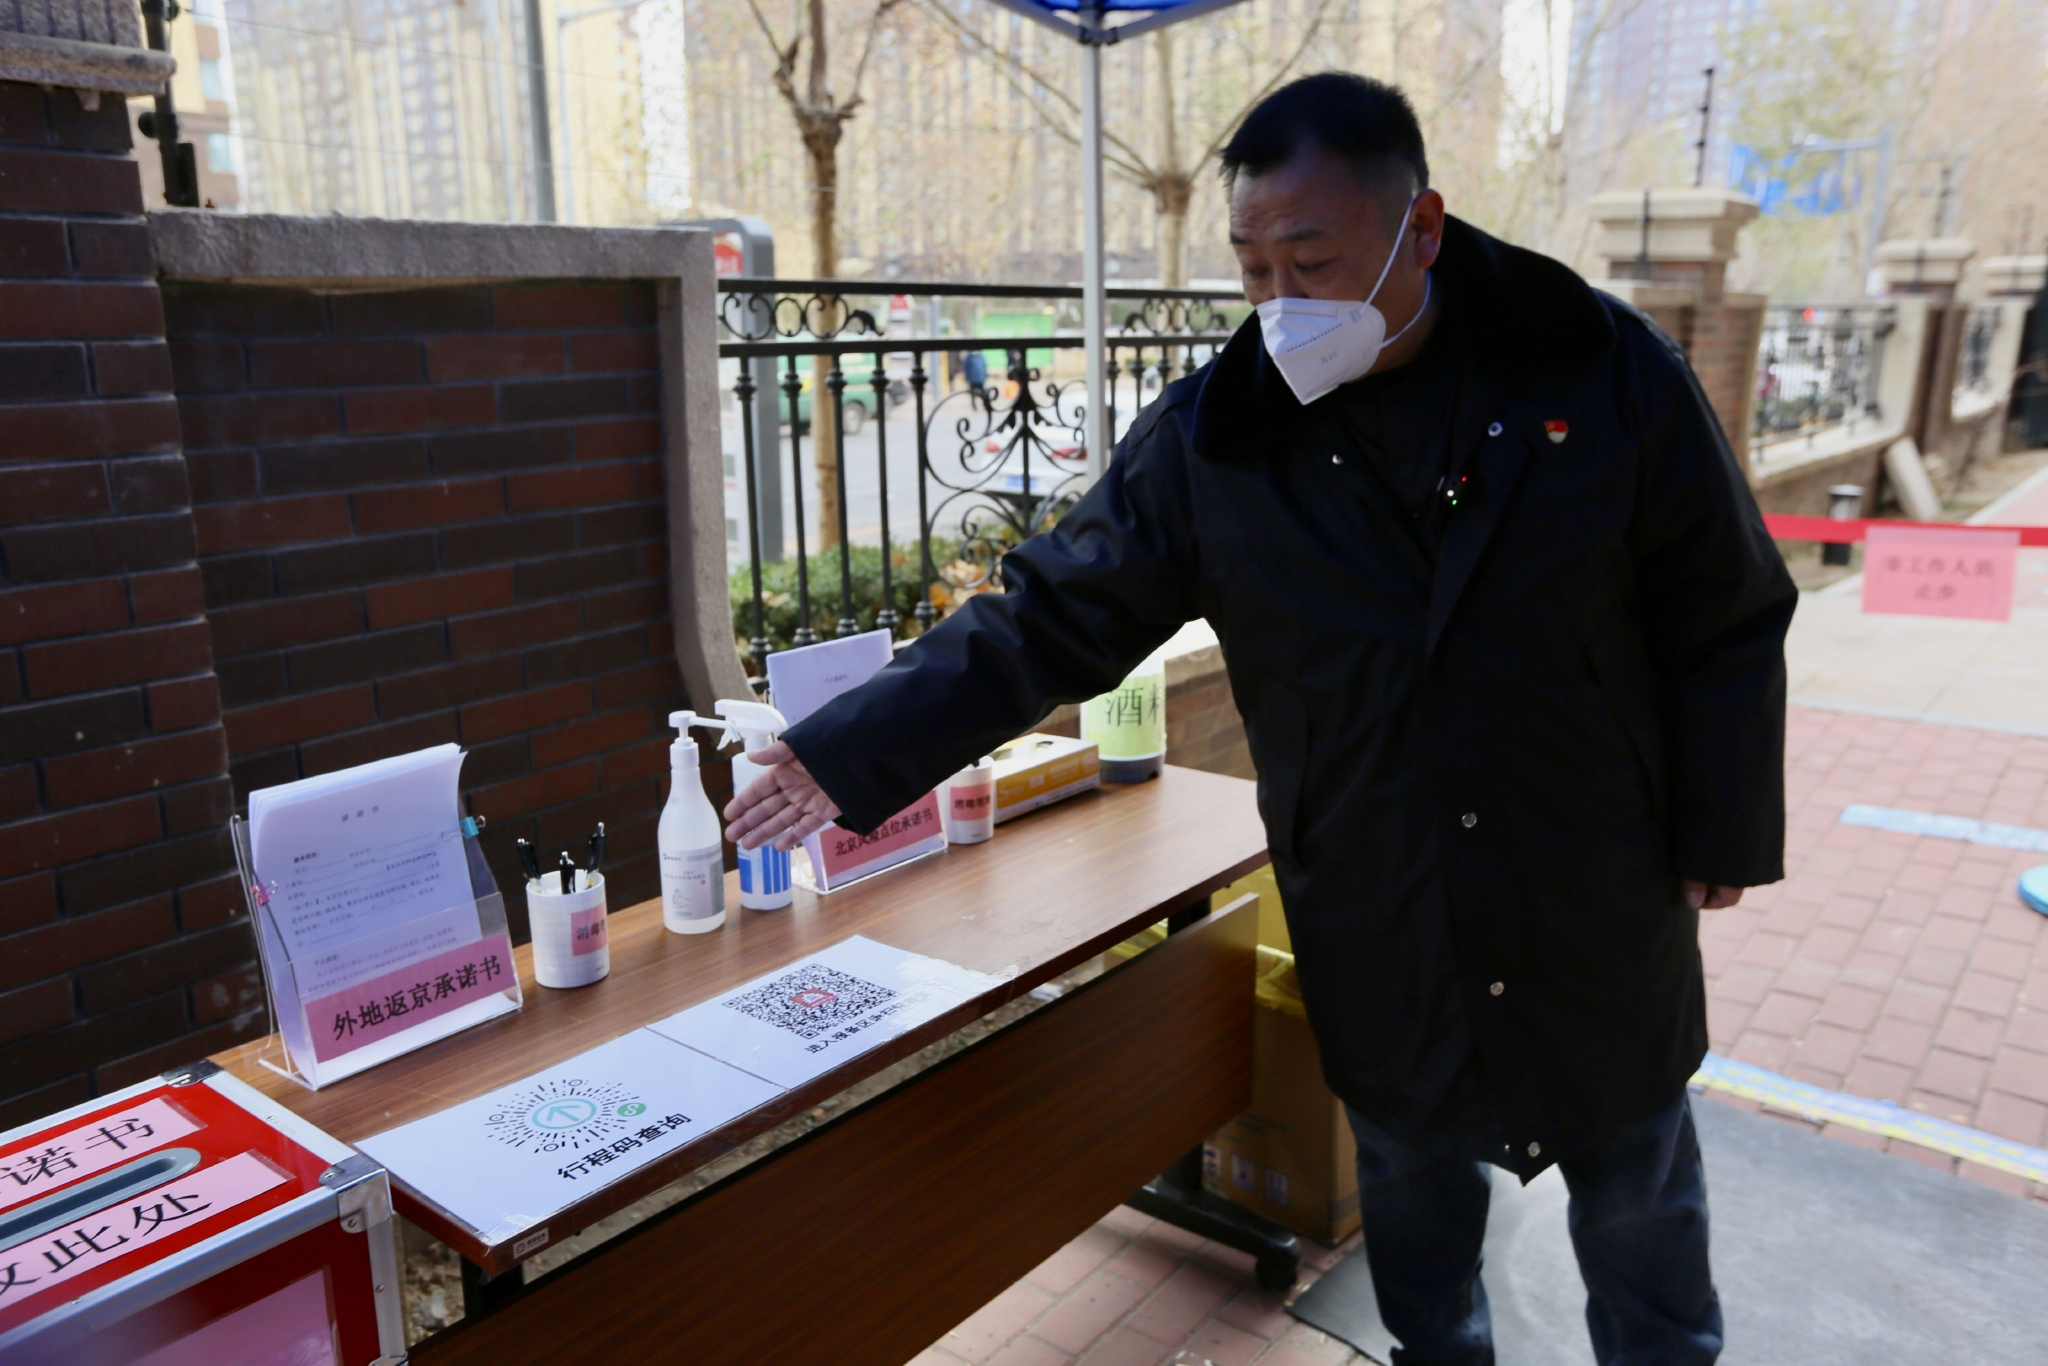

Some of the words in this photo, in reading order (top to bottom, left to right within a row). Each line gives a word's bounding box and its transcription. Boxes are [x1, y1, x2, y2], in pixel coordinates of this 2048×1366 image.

[332, 954, 501, 1041] 外地返京承诺书
[557, 1112, 693, 1181] 行程码查询
